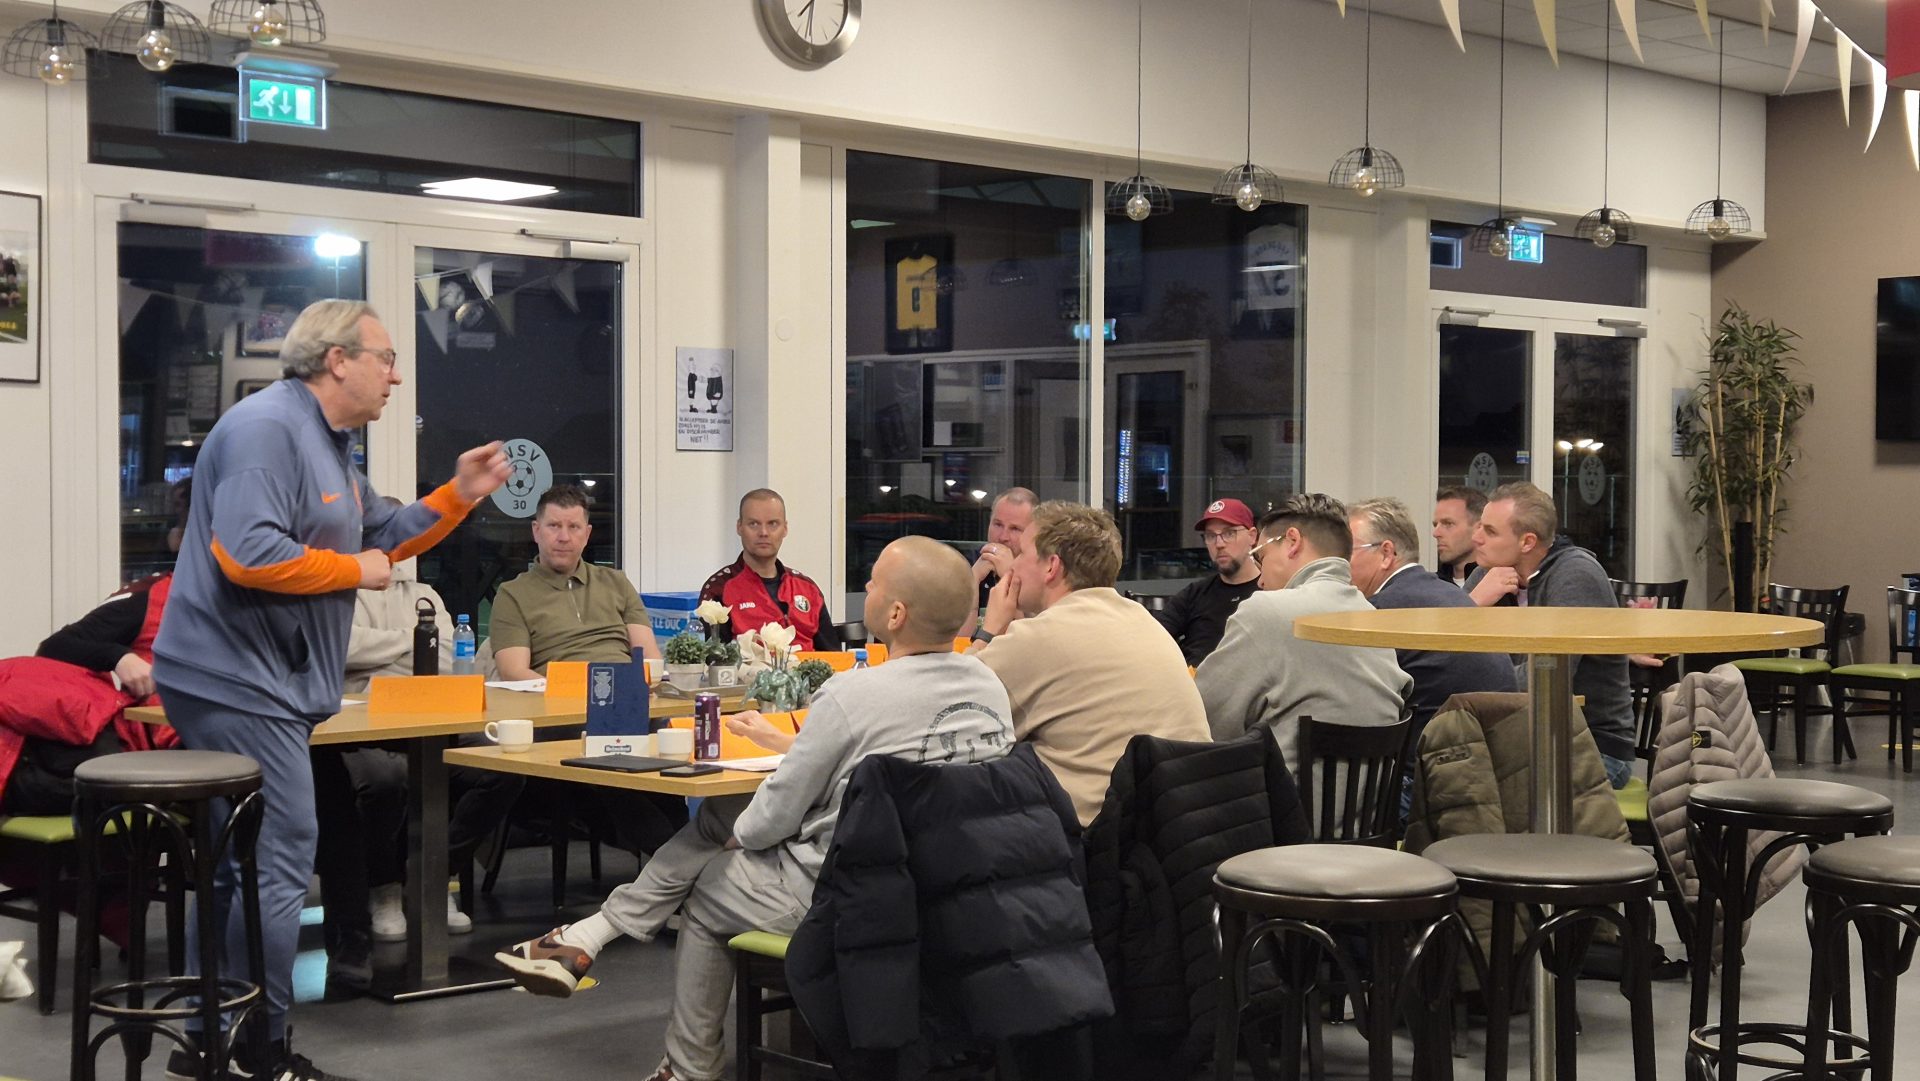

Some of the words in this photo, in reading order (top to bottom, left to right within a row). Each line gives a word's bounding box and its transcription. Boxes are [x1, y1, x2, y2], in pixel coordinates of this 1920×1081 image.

[513, 500, 526, 509] 30
[739, 602, 756, 610] JAKO
[721, 671, 732, 683] 2
